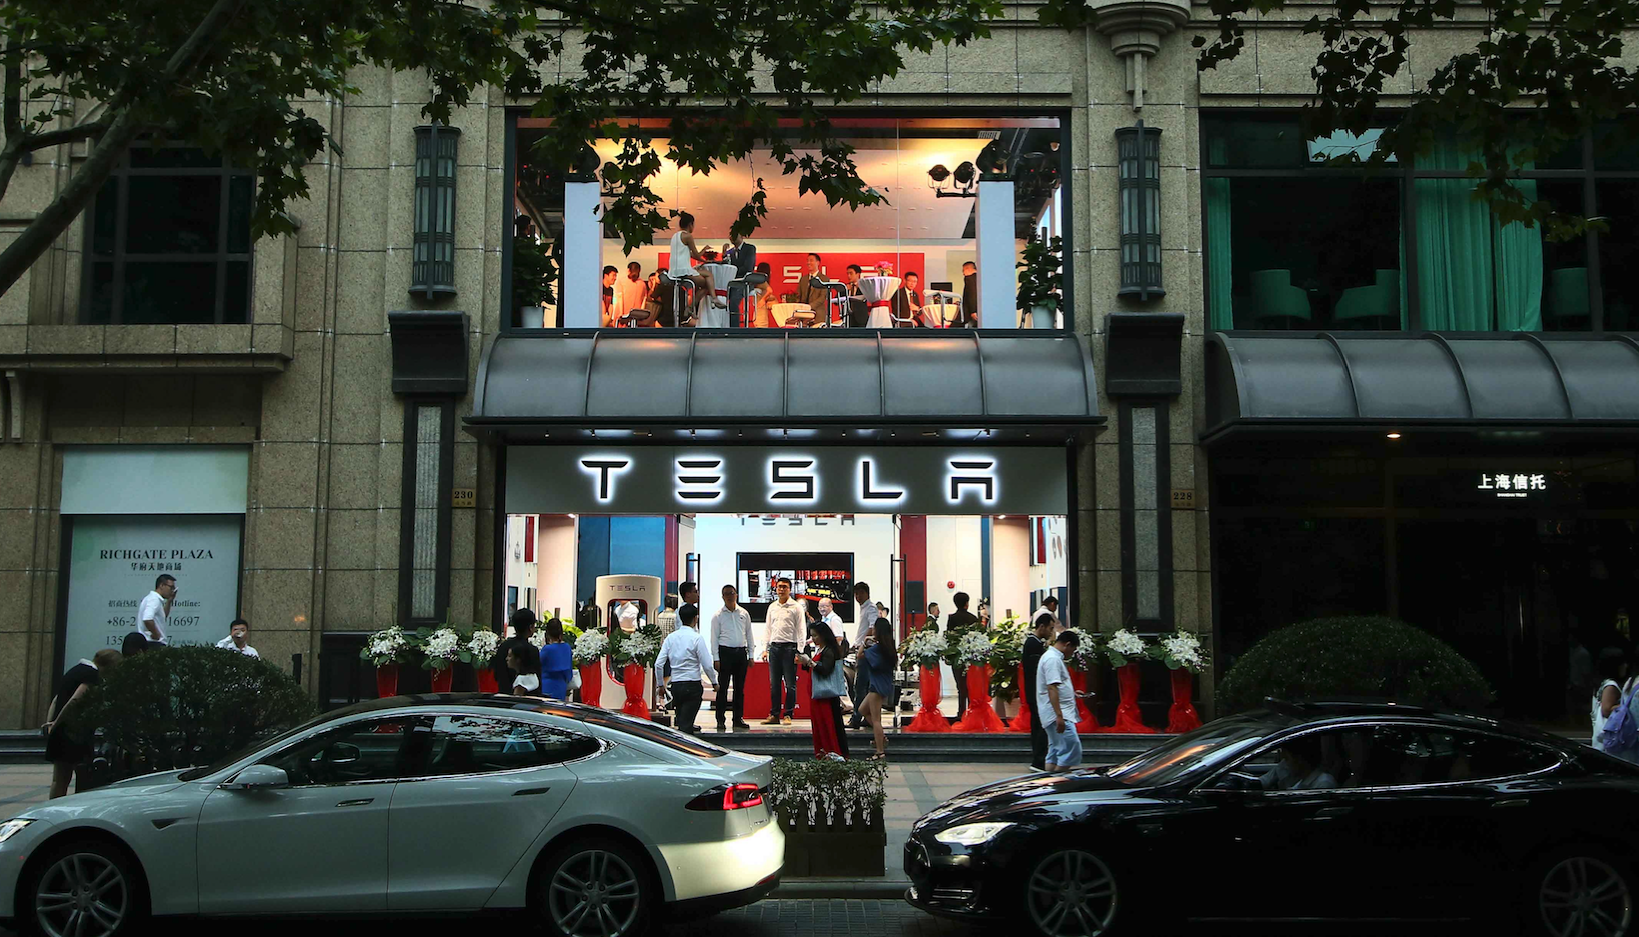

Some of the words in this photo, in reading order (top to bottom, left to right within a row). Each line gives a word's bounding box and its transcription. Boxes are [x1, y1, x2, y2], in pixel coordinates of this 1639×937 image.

[580, 460, 994, 500] TESLA
[1477, 473, 1546, 490] 上海信托
[454, 490, 473, 499] 230
[1173, 491, 1192, 501] 228
[100, 550, 167, 560] RICHGATE
[171, 549, 213, 560] PLAZA
[131, 562, 182, 572] 华府天地商场
